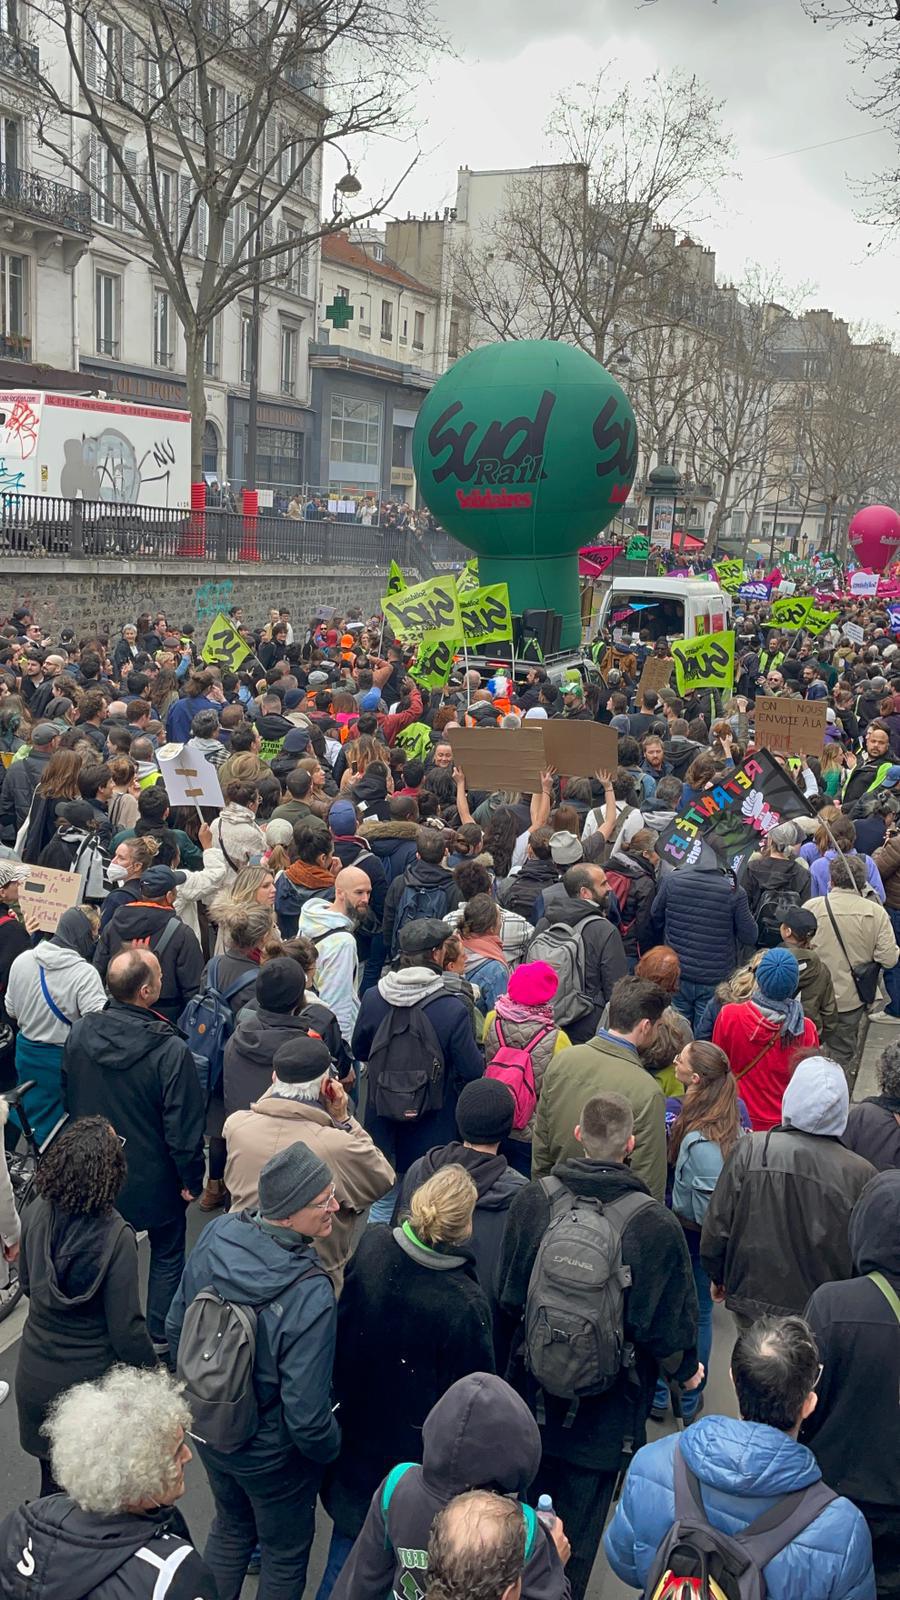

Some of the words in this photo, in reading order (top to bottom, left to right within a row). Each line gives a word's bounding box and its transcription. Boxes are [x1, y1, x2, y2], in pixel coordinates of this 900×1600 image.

[427, 389, 557, 484] Sud
[473, 454, 548, 486] Rail
[456, 488, 534, 509] Solidaires
[762, 701, 777, 711] ON
[797, 704, 823, 716] NOUS
[759, 713, 799, 726] ENVOIE
[811, 719, 822, 729] LA
